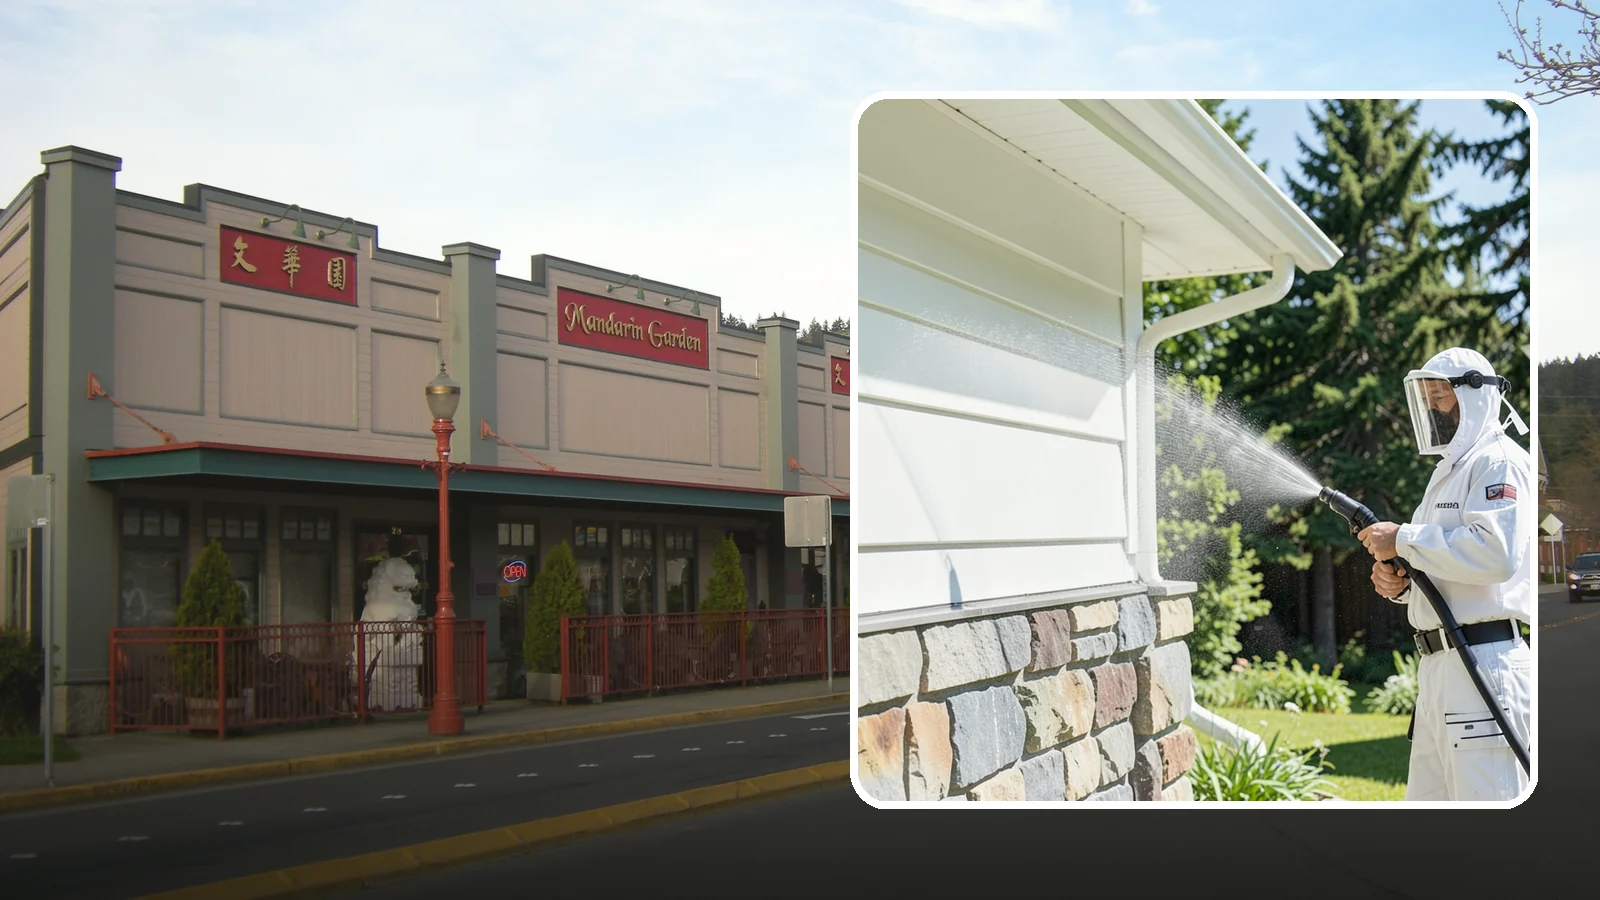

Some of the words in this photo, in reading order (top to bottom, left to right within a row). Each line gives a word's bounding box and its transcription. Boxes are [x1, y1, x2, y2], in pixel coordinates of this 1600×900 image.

[231, 236, 346, 291] 文華園
[565, 302, 644, 341] Mandarin
[648, 320, 701, 352] Garden
[503, 565, 527, 578] OPEN
